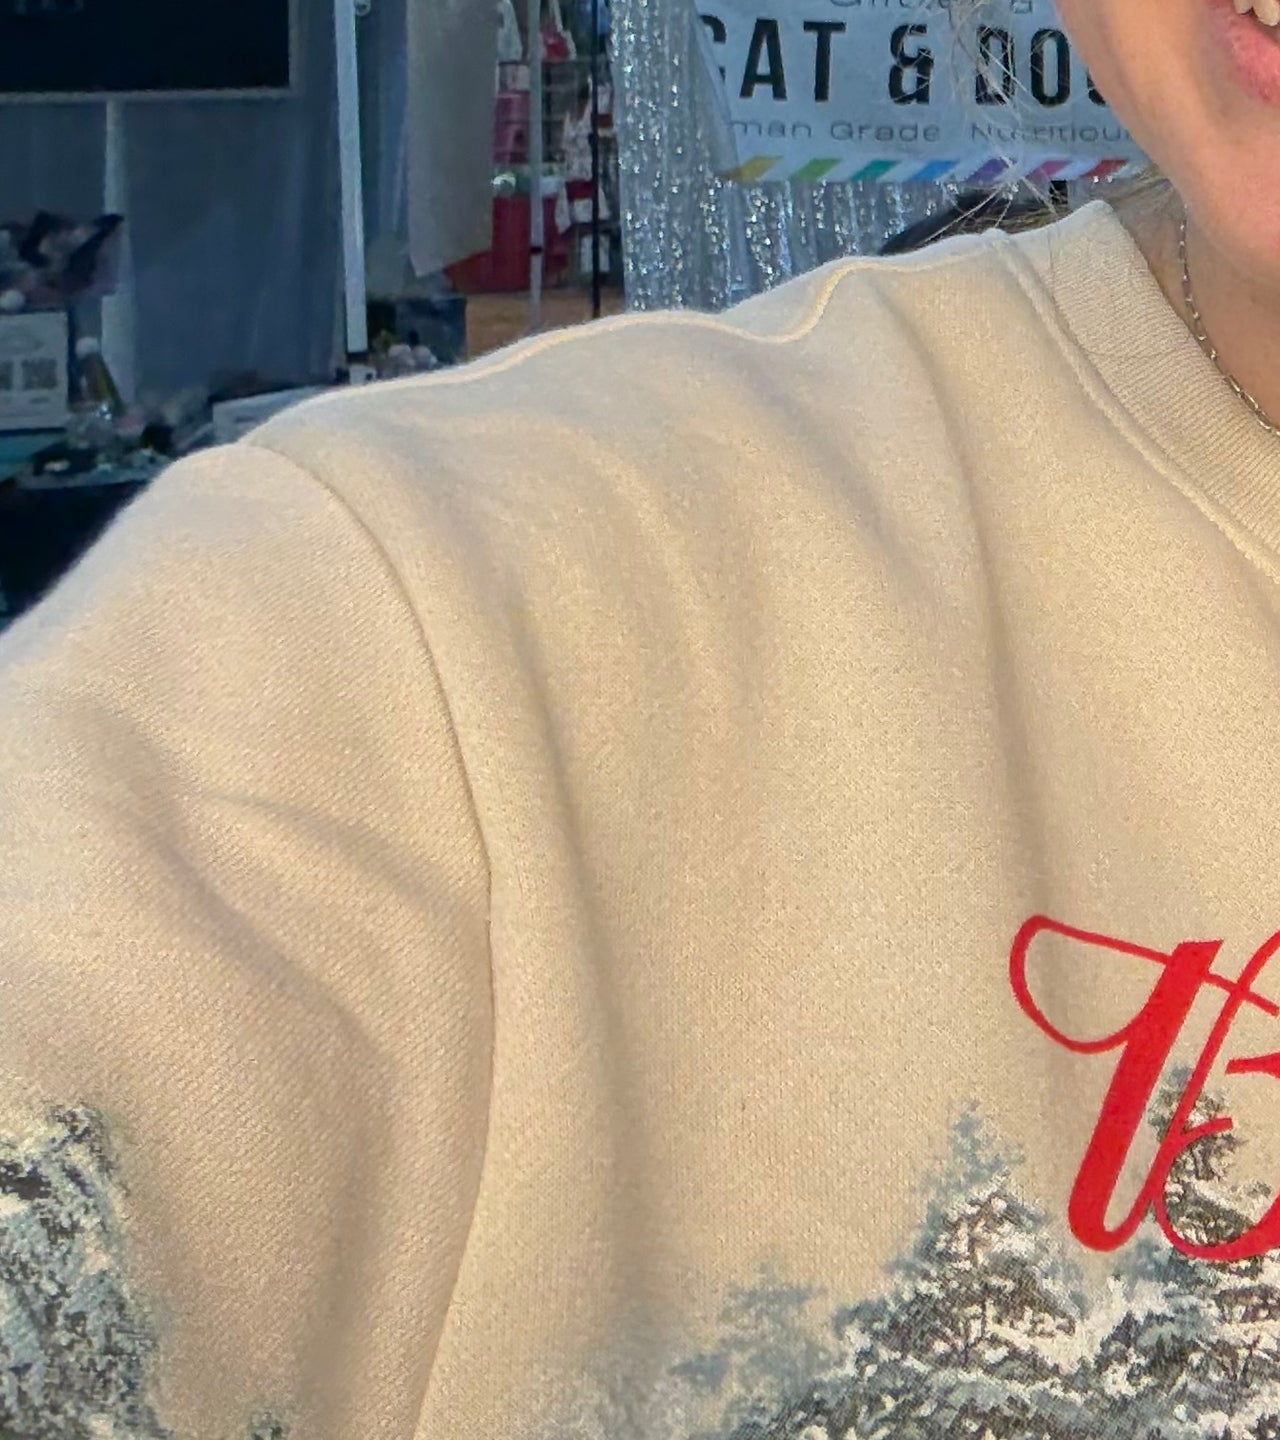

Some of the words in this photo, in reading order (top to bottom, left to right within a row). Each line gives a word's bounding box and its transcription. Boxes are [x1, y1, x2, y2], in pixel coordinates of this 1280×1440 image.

[975, 24, 1106, 109] DO
[728, 119, 813, 139] man
[829, 119, 941, 143] Grade
